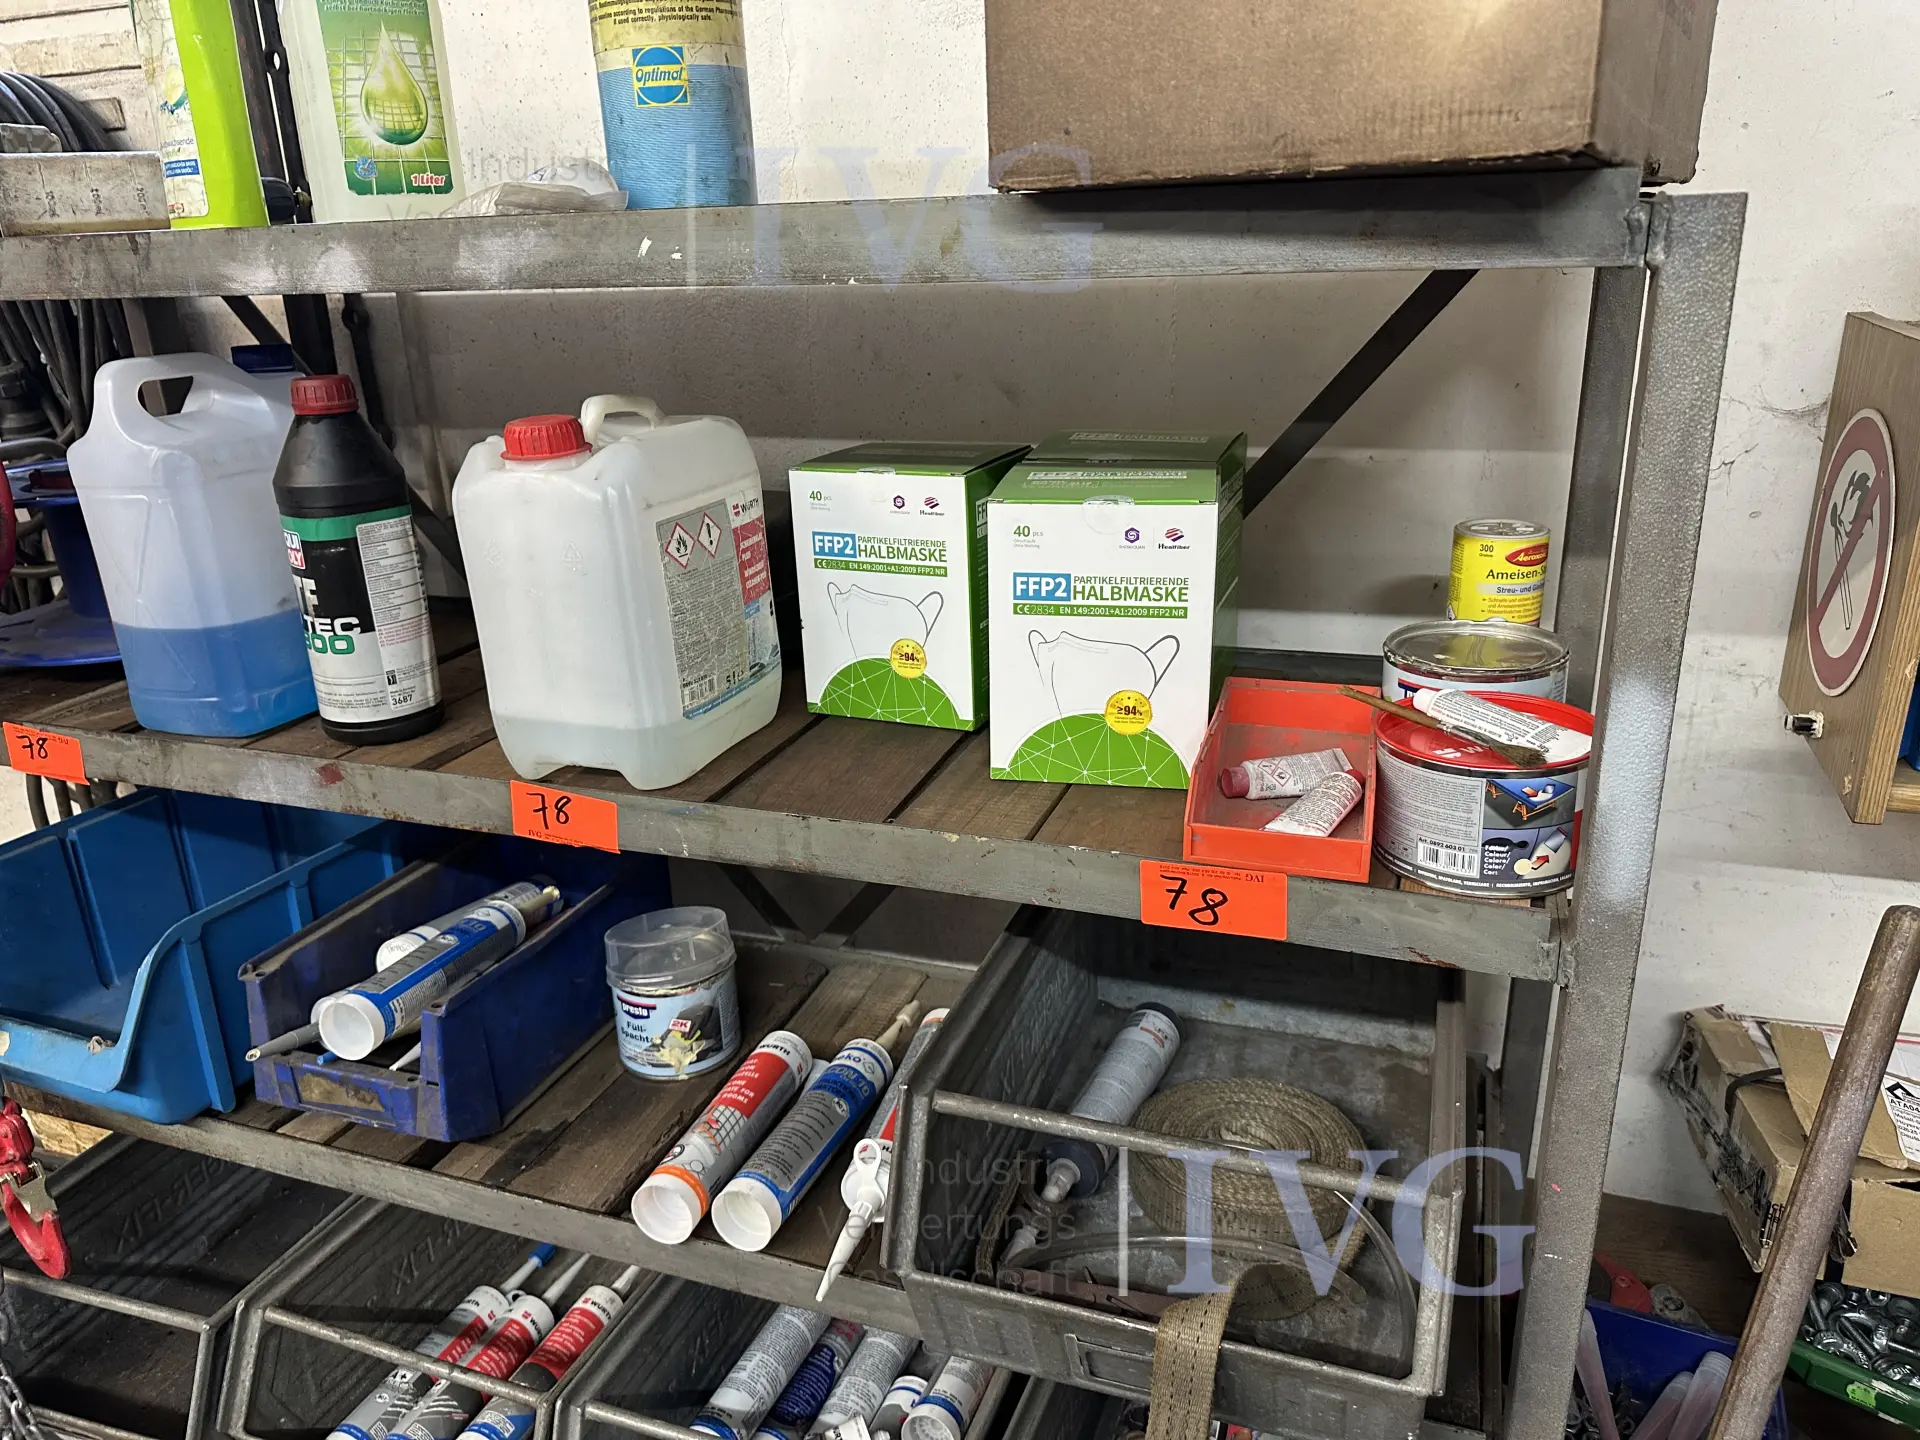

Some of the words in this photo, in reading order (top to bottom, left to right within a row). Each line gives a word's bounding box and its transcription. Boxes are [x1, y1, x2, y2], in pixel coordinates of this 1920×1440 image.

[635, 67, 683, 86] Optimal
[420, 173, 446, 187] Liter
[809, 490, 823, 502] 40
[1013, 525, 1031, 537] 40
[814, 534, 854, 555] FFP2
[857, 535, 947, 549] PARTIKELFILTRIERENDE
[1479, 544, 1494, 552] 300
[857, 544, 948, 563] HALBMASKE
[849, 562, 857, 570] EN
[859, 563, 917, 574] 149:2001+A1:2009
[917, 566, 935, 575] FFP2
[935, 568, 946, 576] NR
[1015, 576, 1067, 598] FFP2
[1073, 576, 1189, 586] PARTIKELFILTRIERENDE
[1073, 585, 1189, 603] HALBMASKE
[1496, 586, 1518, 594] Streu-
[1519, 585, 1531, 593] und
[1059, 606, 1071, 614] EN
[1073, 606, 1147, 616] 149:2001+A1:2009
[1149, 608, 1170, 616] FFP2
[1172, 609, 1185, 617] NR
[391, 693, 413, 706] 3687
[16, 735, 48, 760] 78
[526, 792, 573, 831] 78
[1429, 839, 1444, 848] 0892
[1444, 843, 1457, 851] 603
[1245, 873, 1265, 883] IVG
[1160, 873, 1229, 926] 78
[626, 1020, 647, 1033] Füll-
[671, 1020, 688, 1028] 2K
[740, 1087, 755, 1098] FOR
